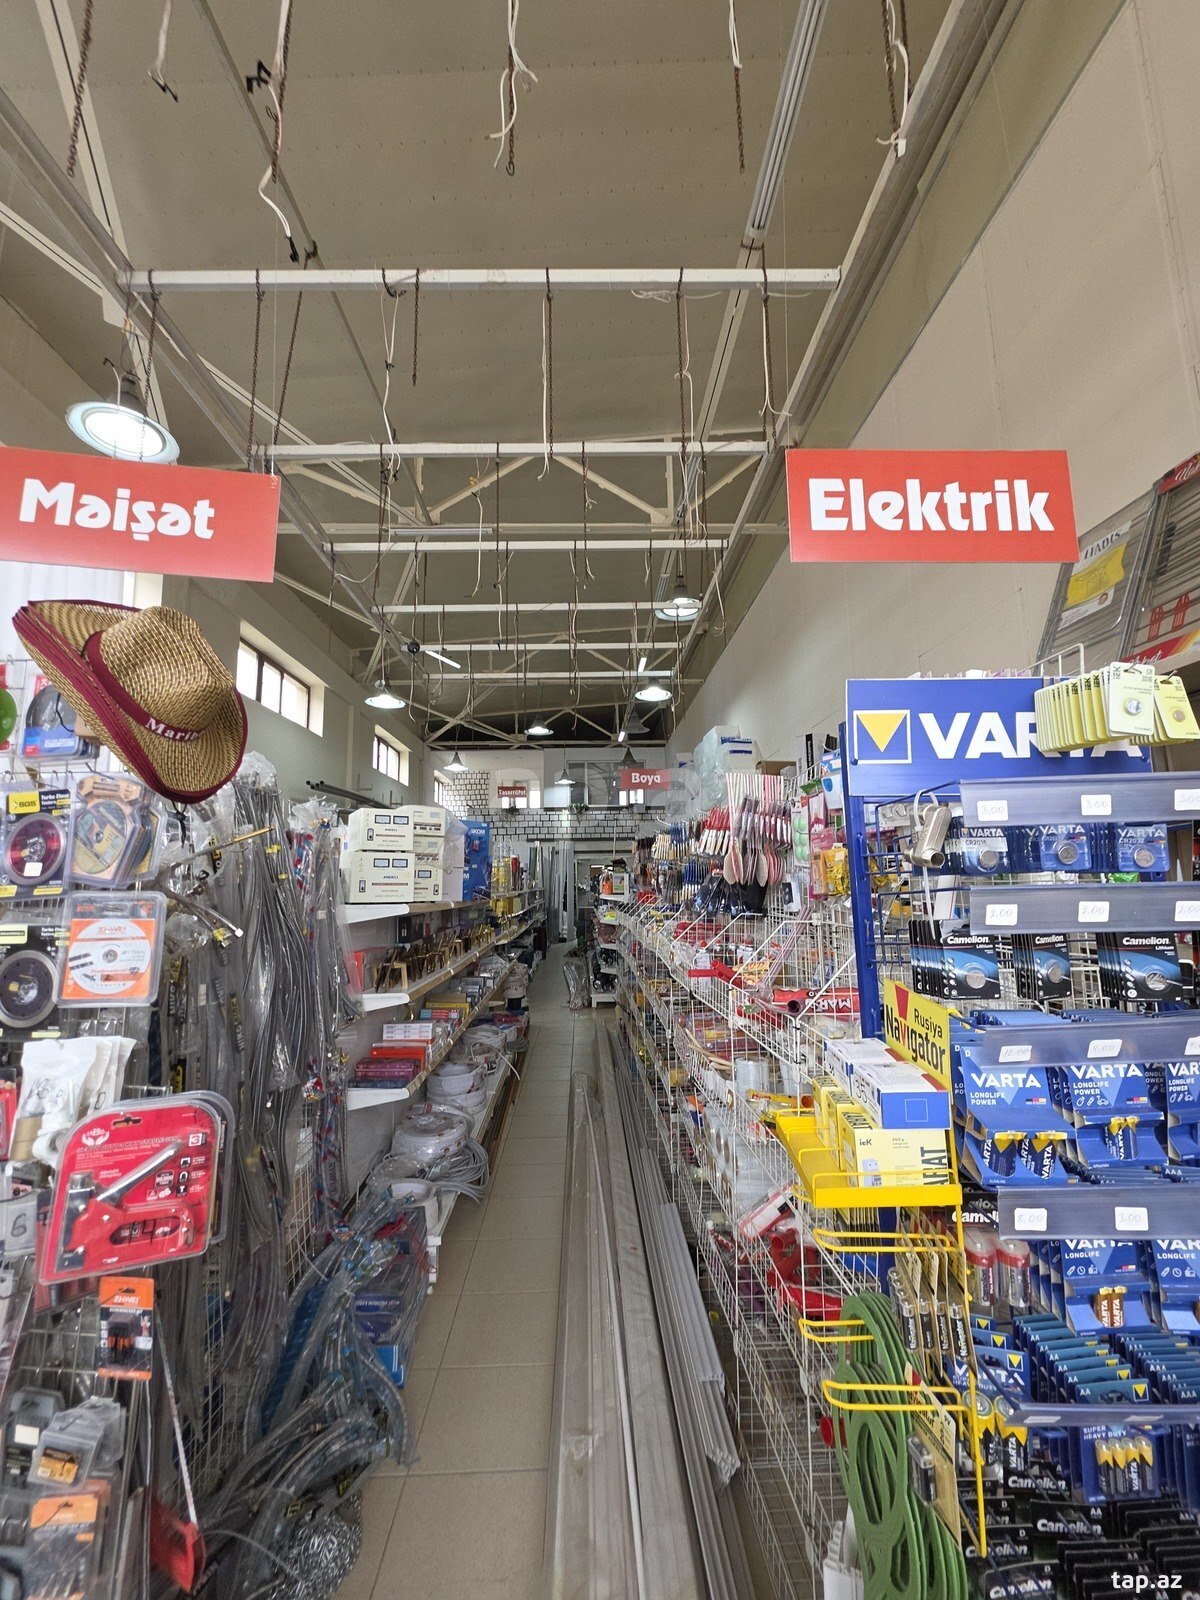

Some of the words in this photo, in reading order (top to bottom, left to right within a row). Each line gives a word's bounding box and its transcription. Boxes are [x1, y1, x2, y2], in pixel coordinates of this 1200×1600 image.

[808, 478, 1055, 532] Elektrik
[918, 712, 1142, 759] VAR
[631, 772, 661, 786] Boya
[970, 828, 1004, 837] VARTA
[1039, 824, 1086, 835] VARTA
[1118, 828, 1165, 837] VARTA
[947, 935, 988, 944] Camelion
[1035, 935, 1064, 944] Camelion
[1123, 937, 1169, 945] Camelion
[914, 1008, 943, 1039] Rusiya
[885, 1004, 946, 1075] Navigator
[1070, 1063, 1143, 1080] VARTA
[970, 1073, 1041, 1088] VARTA
[1073, 1080, 1109, 1088] LONGLIFE
[1041, 1145, 1053, 1179] VARTA
[1065, 1251, 1100, 1259] LONGLIFE
[1157, 1252, 1196, 1260] LONGLIFE
[1112, 1299, 1120, 1326] VARTA
[1068, 1375, 1078, 1383] AA
[1080, 1388, 1091, 1396] AA
[1083, 1425, 1106, 1434] SUPER
[1108, 1430, 1127, 1438] DUTY
[1008, 1437, 1017, 1467] VARTA
[1130, 1461, 1139, 1491] VARTA
[1090, 1507, 1102, 1515] AA
